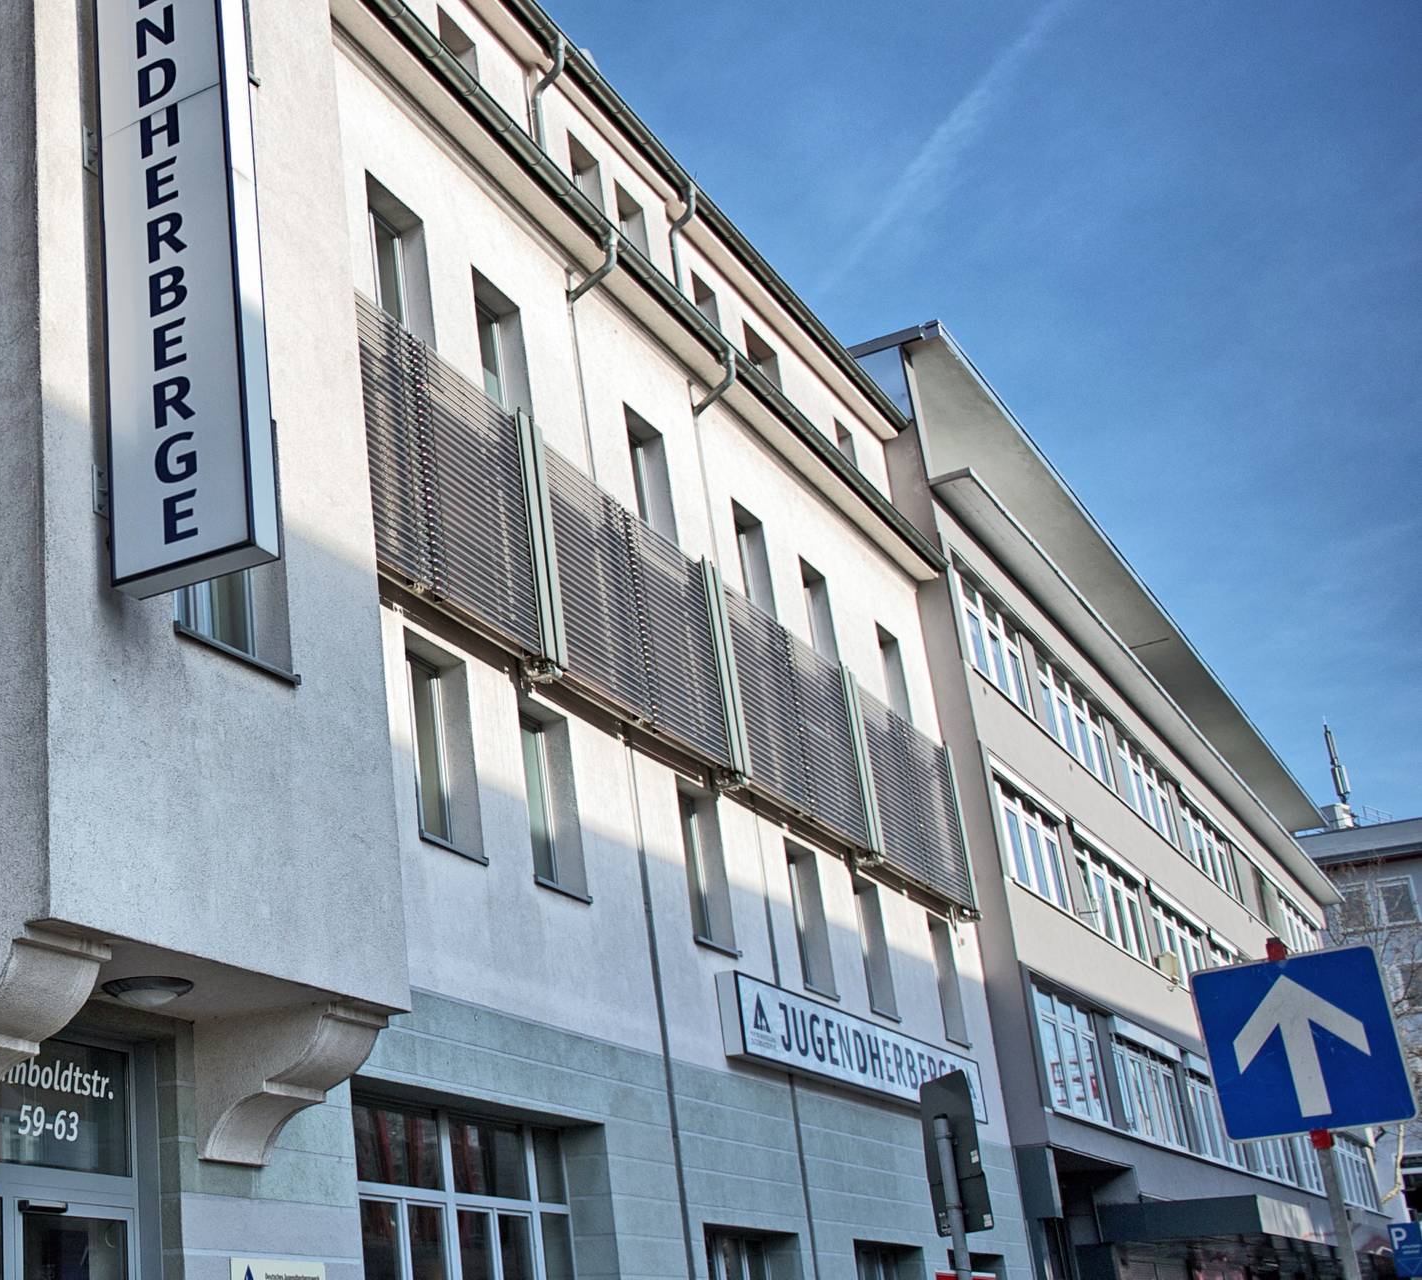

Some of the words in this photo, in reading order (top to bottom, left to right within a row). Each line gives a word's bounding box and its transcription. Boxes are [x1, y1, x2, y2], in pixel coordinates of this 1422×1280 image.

[135, 0, 199, 545] NDHERBERGE
[18, 1104, 79, 1142] 59-63
[1390, 1227, 1407, 1250] P
